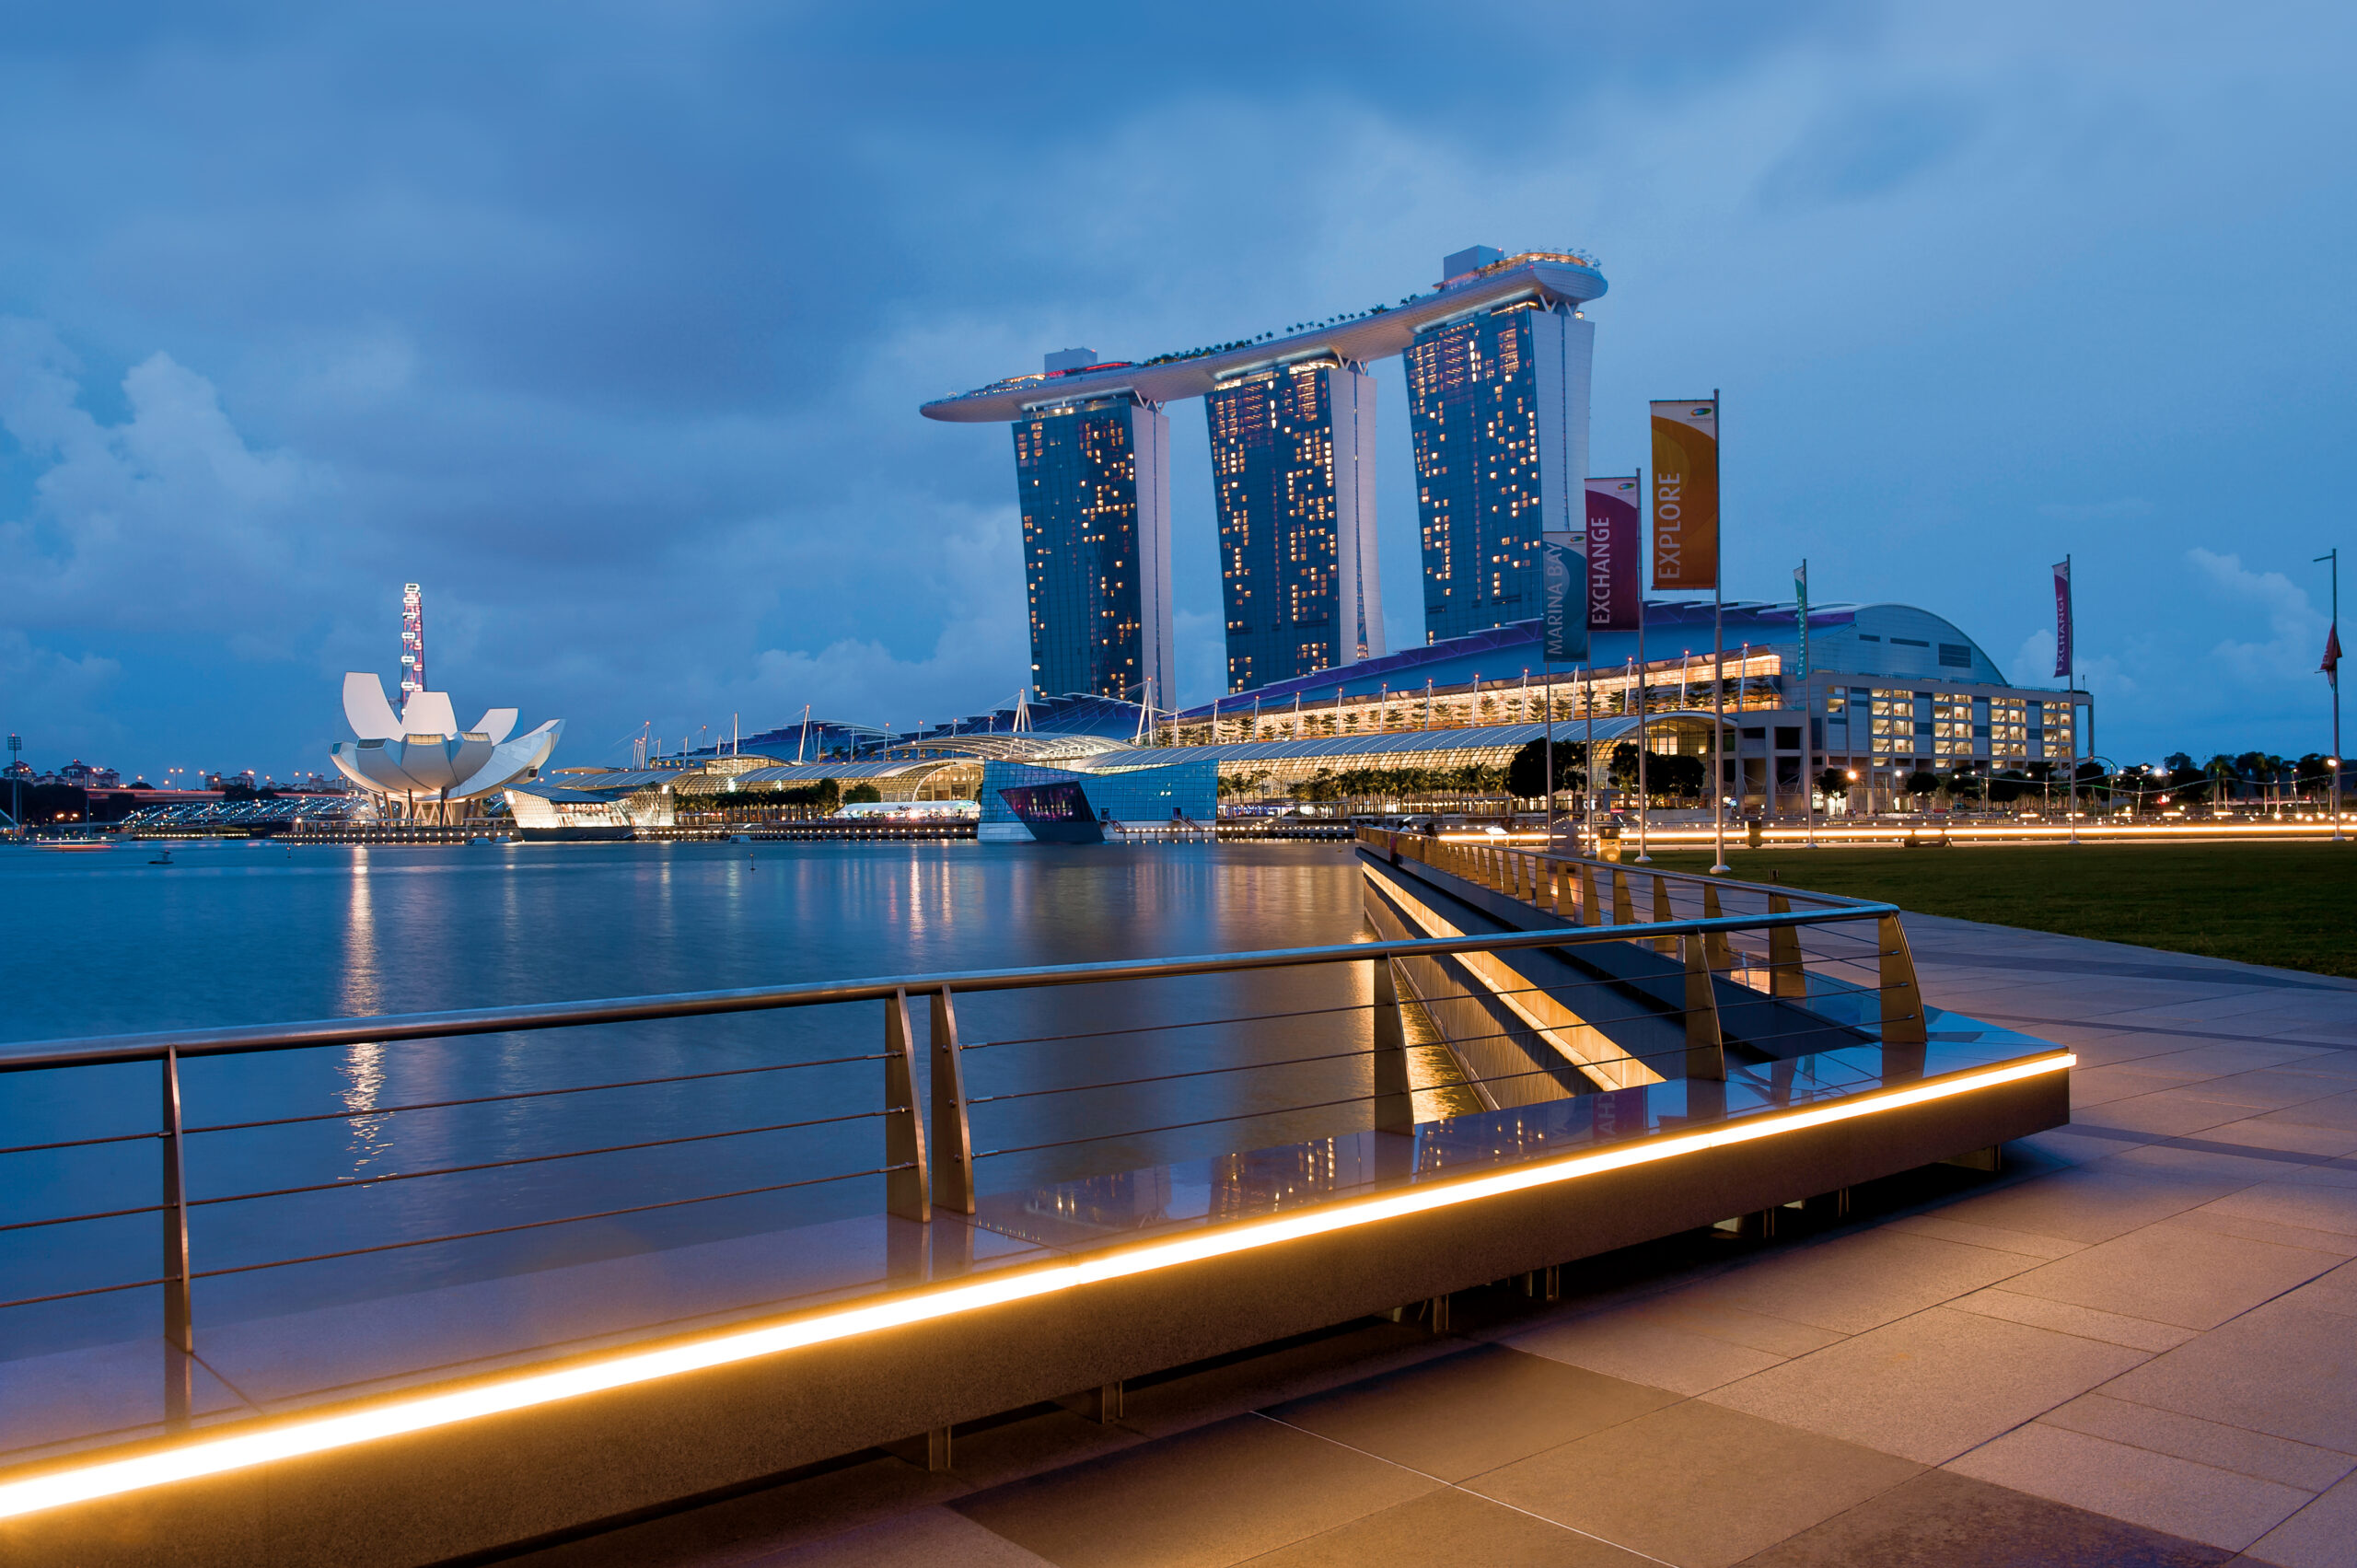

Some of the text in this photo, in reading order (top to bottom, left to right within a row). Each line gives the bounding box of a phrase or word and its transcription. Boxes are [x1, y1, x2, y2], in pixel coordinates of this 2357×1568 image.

[1591, 517, 1610, 624] EXCHANGE
[1658, 472, 1680, 579] EXPLORE
[1547, 543, 1562, 655] MARINA BAY
[2057, 594, 2065, 671] EXCHANGE
